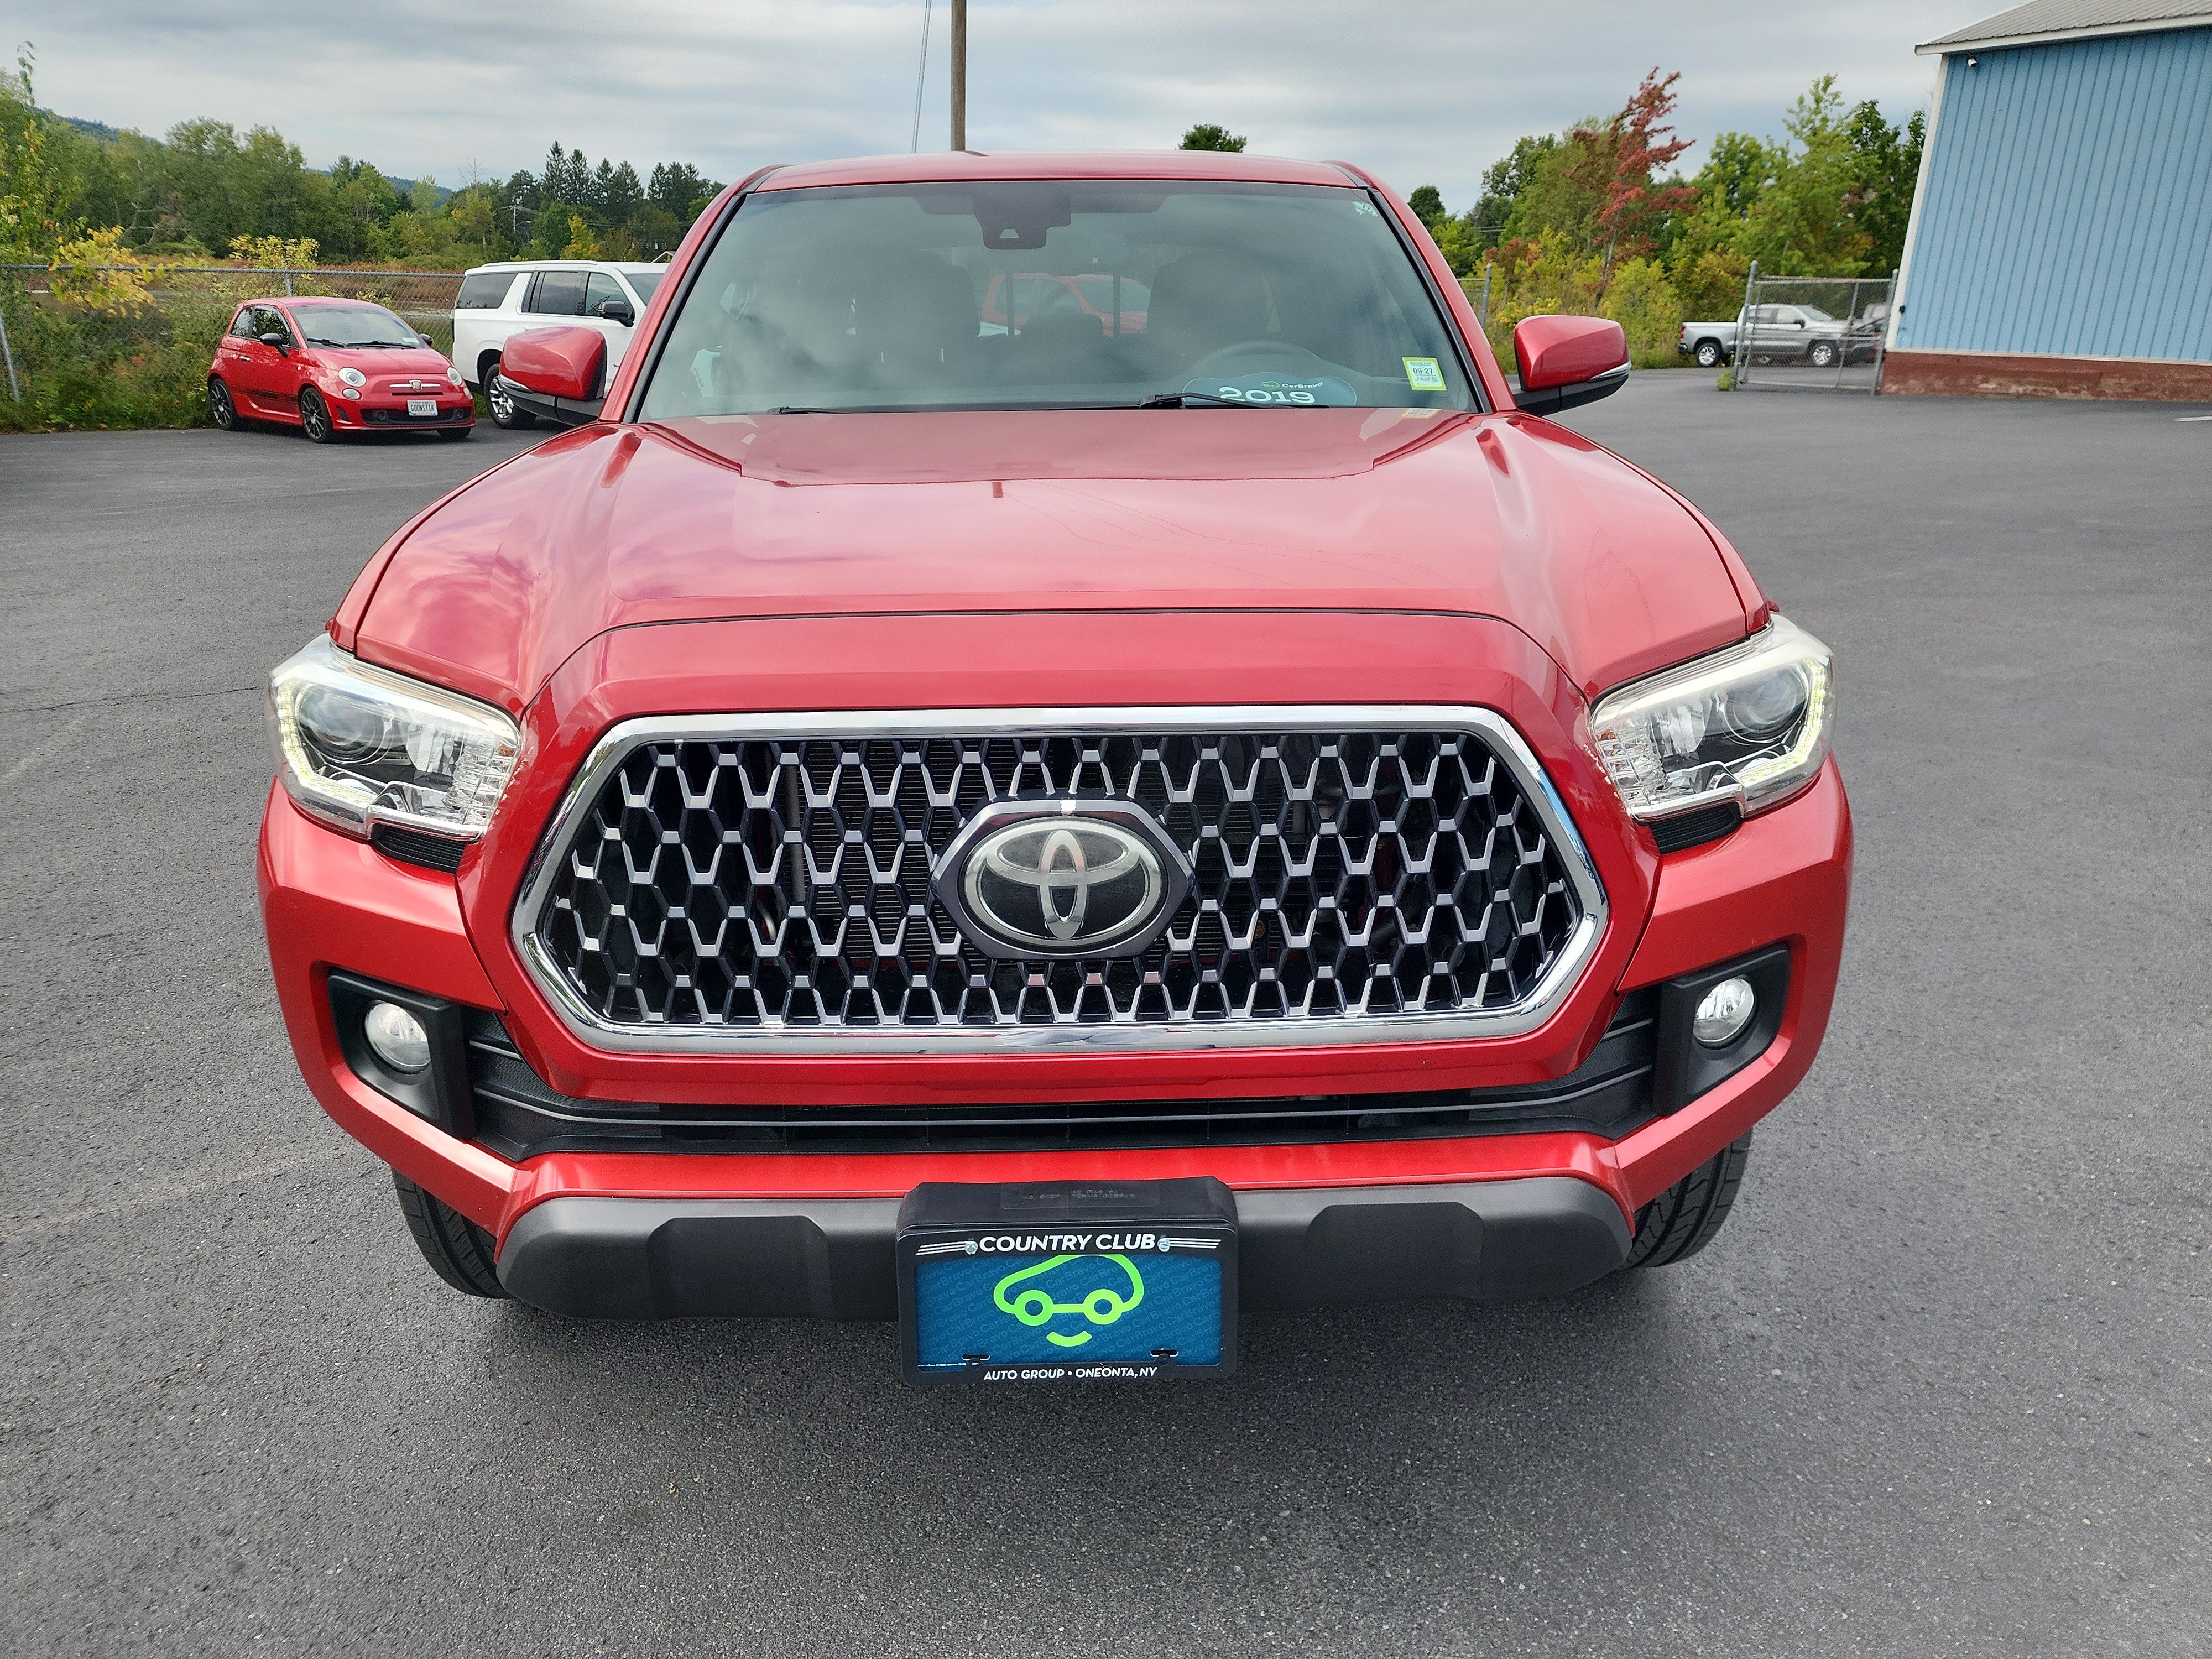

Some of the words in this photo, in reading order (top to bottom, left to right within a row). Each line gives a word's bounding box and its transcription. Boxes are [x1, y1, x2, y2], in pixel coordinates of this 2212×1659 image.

[1218, 386, 1316, 404] 2019
[979, 1234, 1093, 1253] COUNTRY
[1095, 1233, 1156, 1250] CLUB
[983, 1370, 1018, 1380] AUTO
[1020, 1369, 1065, 1379] GROUP
